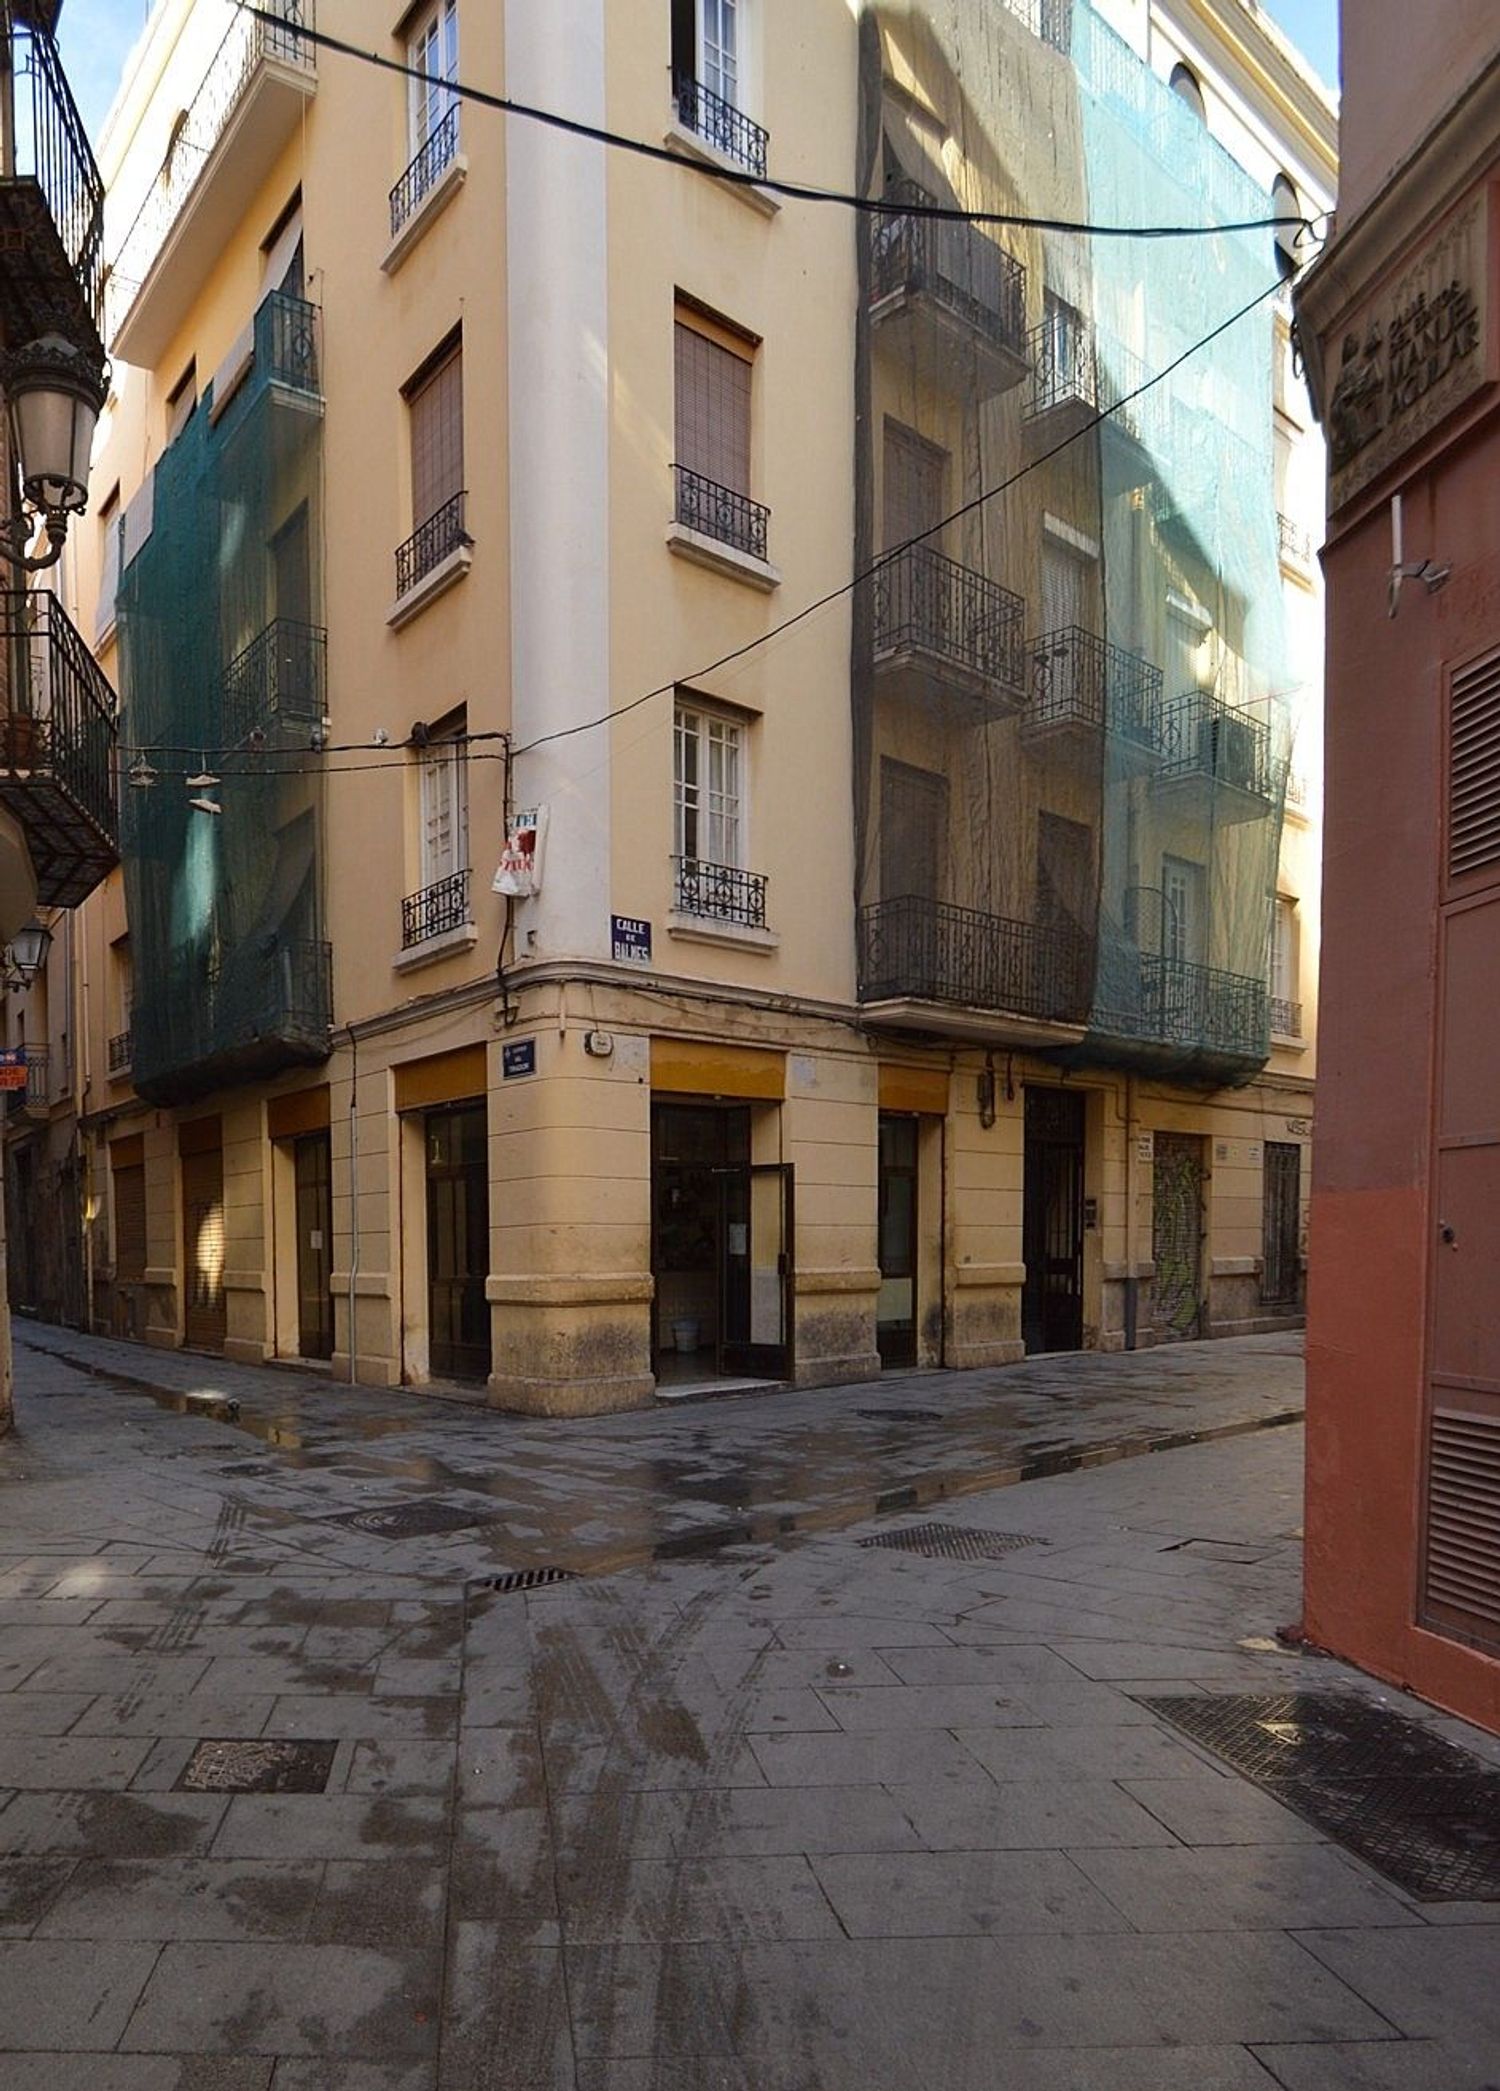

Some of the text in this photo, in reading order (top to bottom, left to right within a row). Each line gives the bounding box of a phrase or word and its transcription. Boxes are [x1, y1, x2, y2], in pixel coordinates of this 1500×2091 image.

[1388, 287, 1478, 392] MANUEL
[1387, 319, 1480, 424] AGUILAR
[614, 941, 649, 961] BALMES
[616, 919, 646, 934] CALLE
